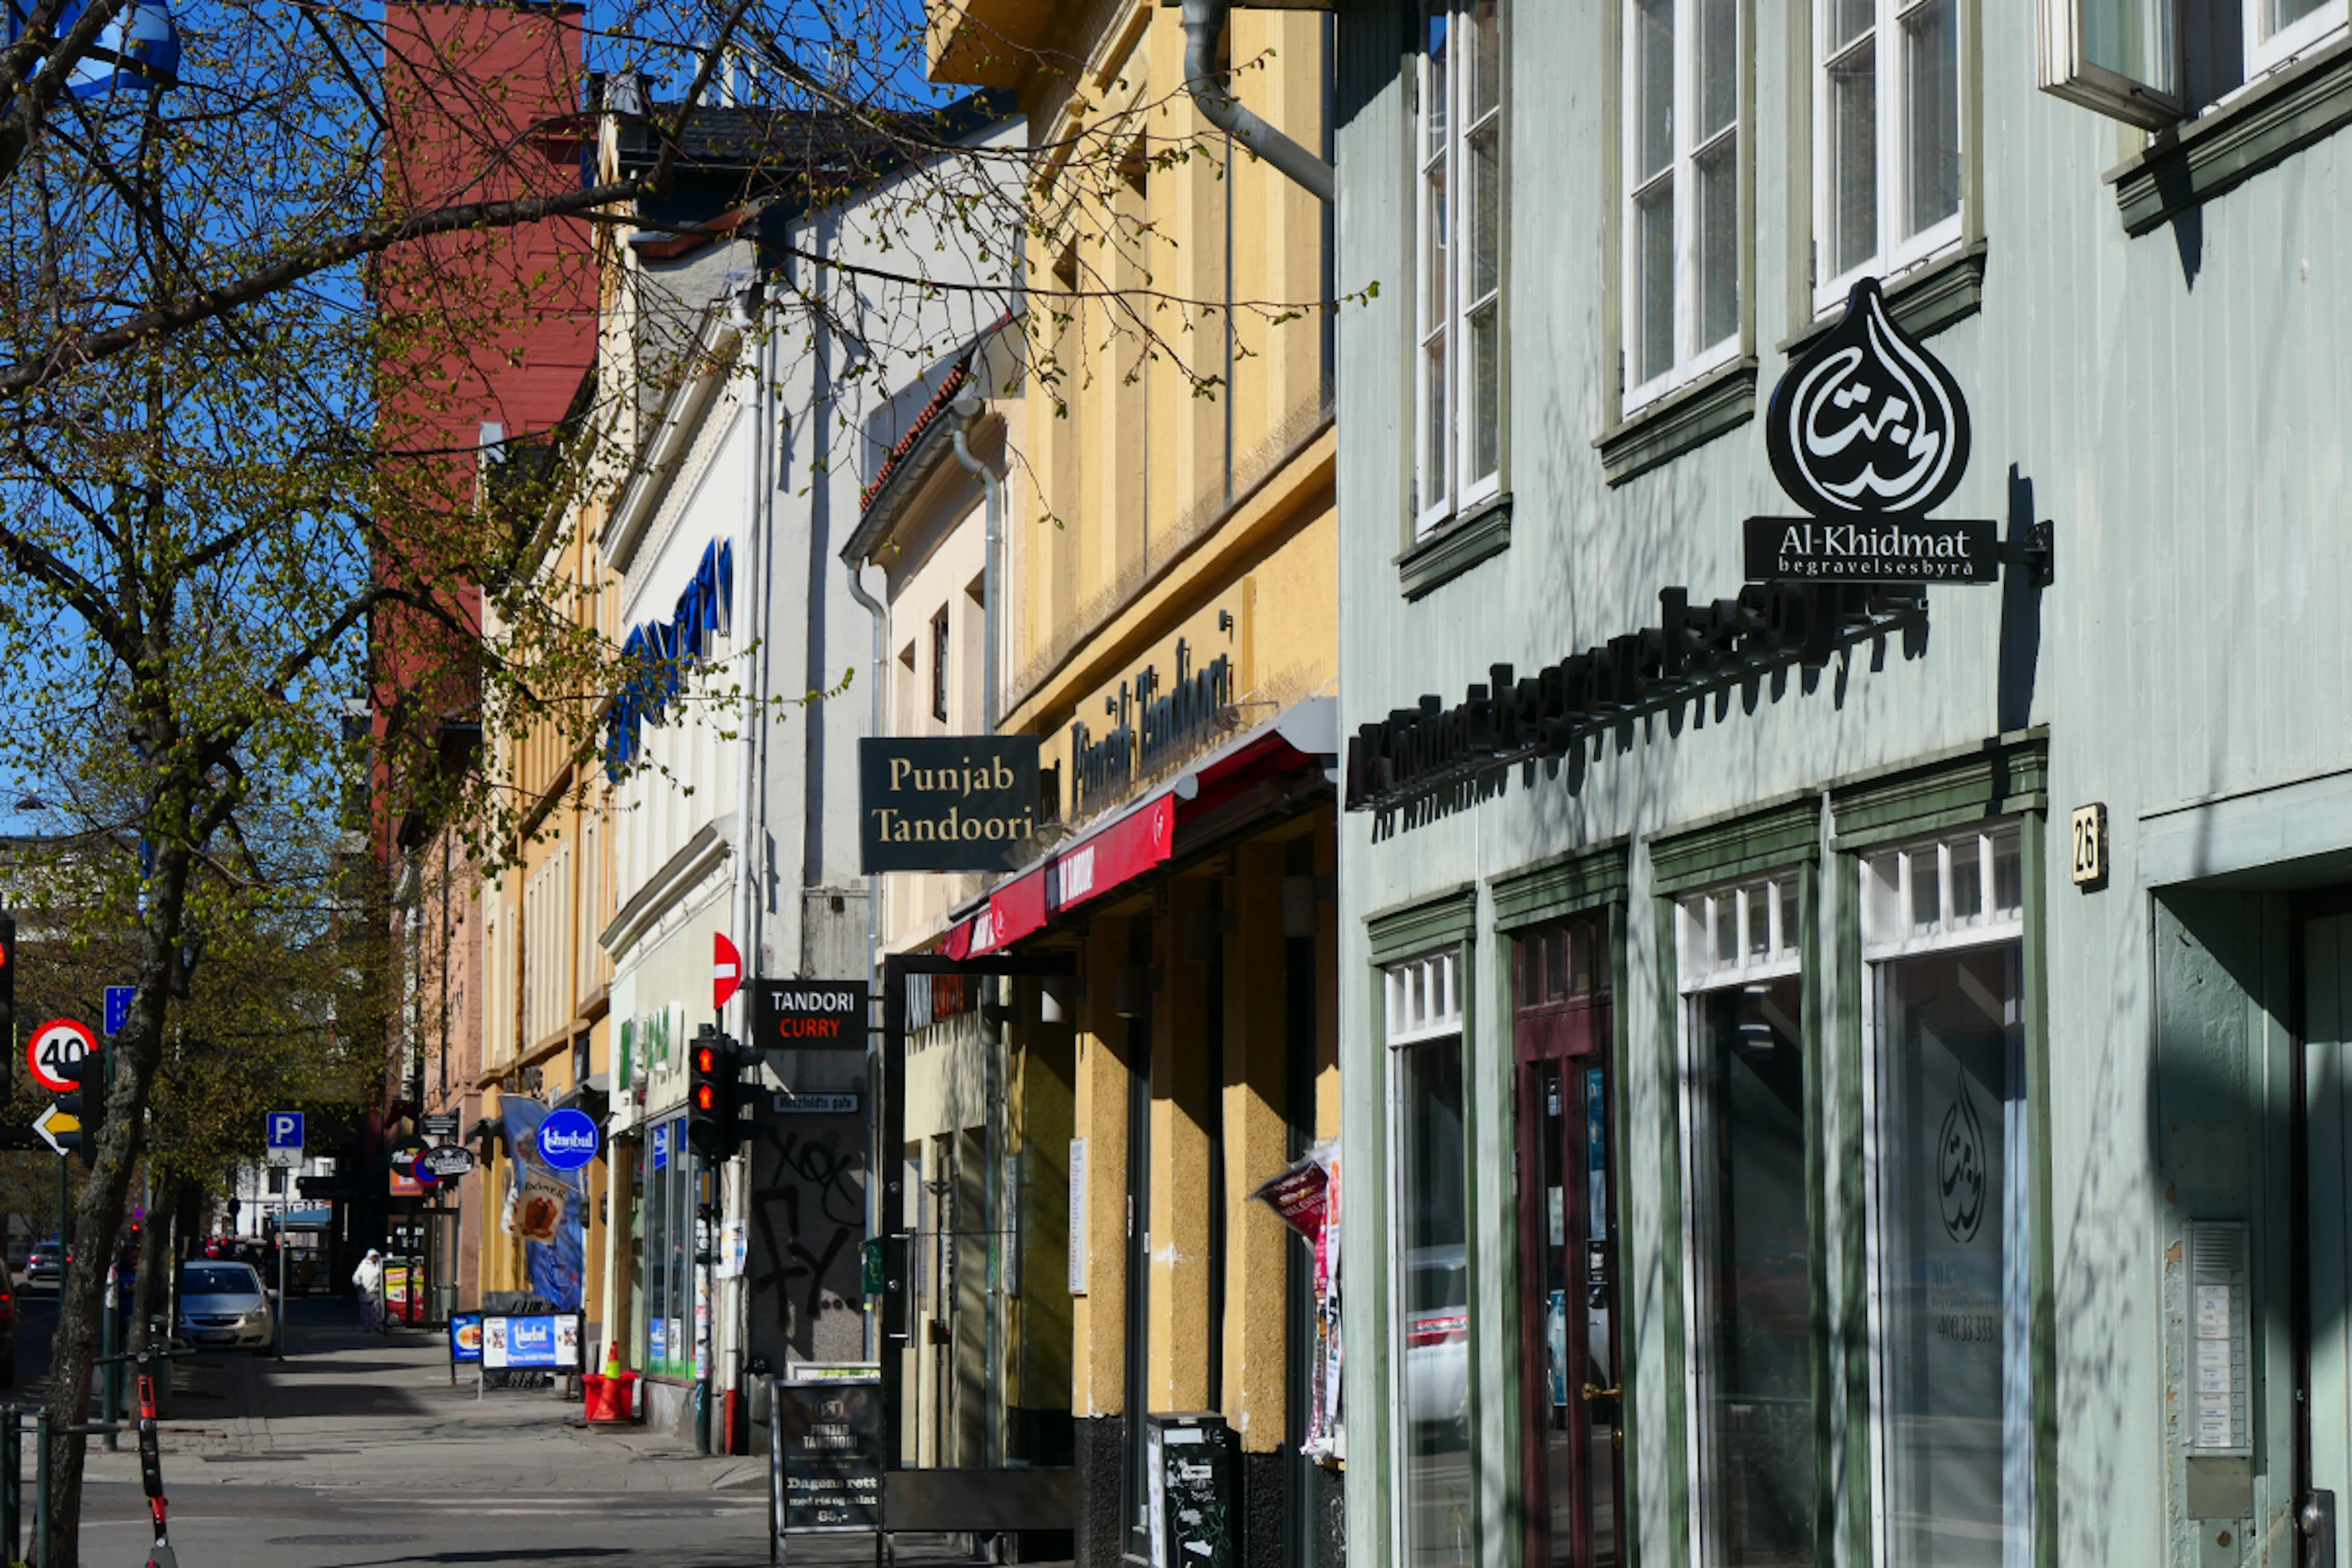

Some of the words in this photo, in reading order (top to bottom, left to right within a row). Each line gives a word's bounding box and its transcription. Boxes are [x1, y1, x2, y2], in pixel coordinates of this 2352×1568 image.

[1779, 524, 1972, 558] Al-Khidmat
[1777, 557, 1973, 577] begravelsesbyrå
[889, 755, 1015, 798] Punjab
[872, 805, 1034, 843] Tandoori
[2075, 816, 2094, 872] 26
[771, 990, 855, 1014] TANDORI
[779, 1017, 841, 1038] CURRY
[40, 1037, 85, 1066] 40
[276, 1116, 295, 1144] P
[1961, 1315, 1973, 1342] 33
[1975, 1315, 1994, 1343] 333
[802, 1435, 858, 1449] TANDOORI
[810, 1423, 850, 1436] PUNJAB
[832, 1498, 846, 1507] og
